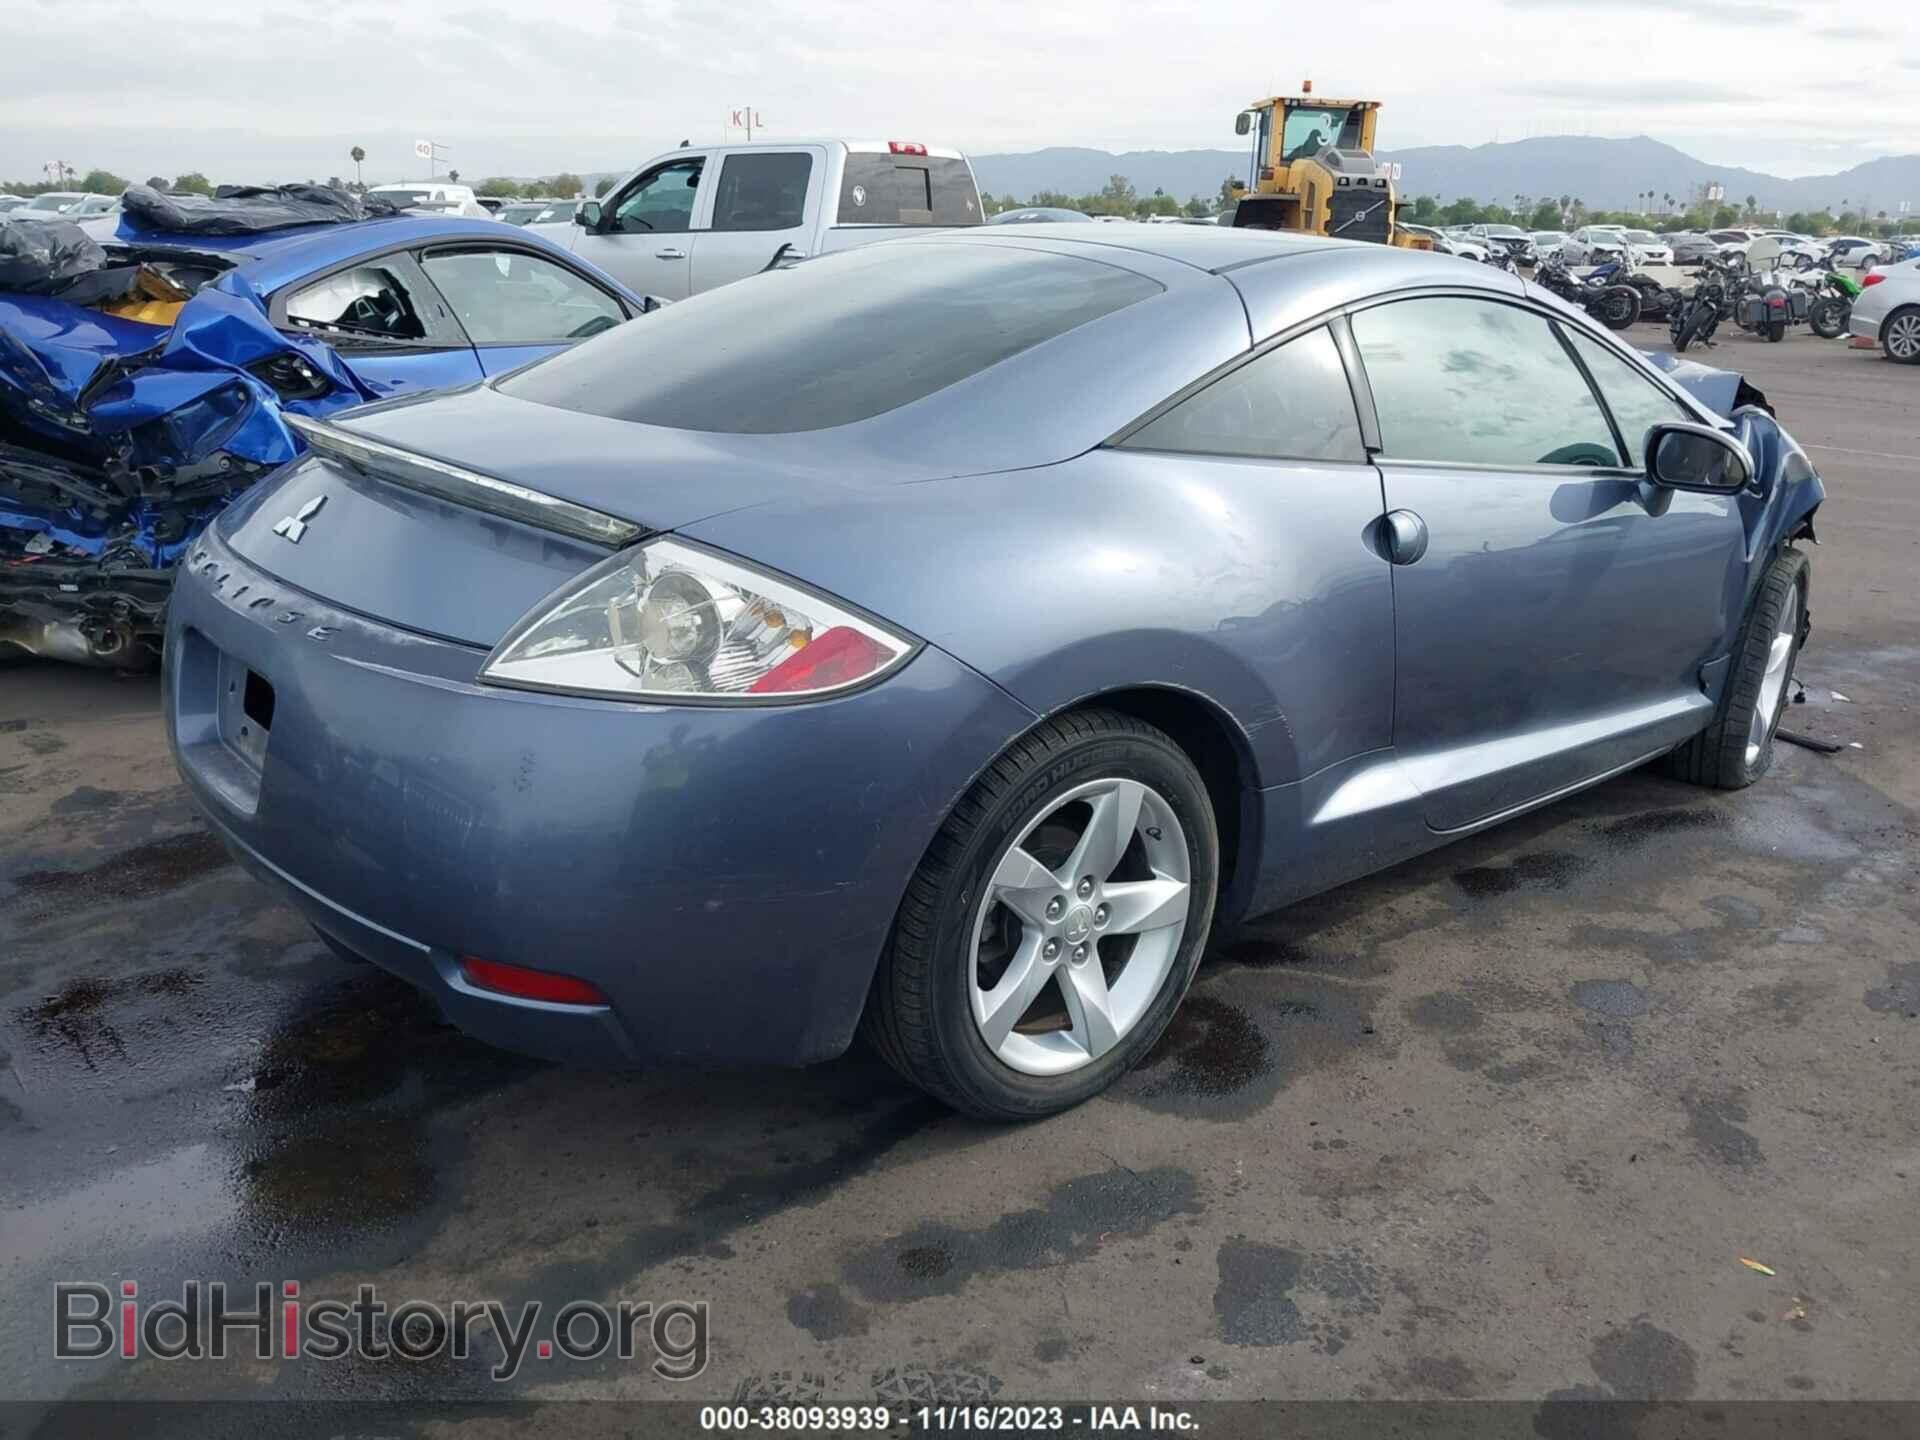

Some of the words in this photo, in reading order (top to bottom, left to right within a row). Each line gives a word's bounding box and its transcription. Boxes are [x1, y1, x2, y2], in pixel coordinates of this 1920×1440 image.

[732, 111, 743, 127] K
[755, 111, 764, 128] L
[191, 551, 343, 642] ECLIPSE
